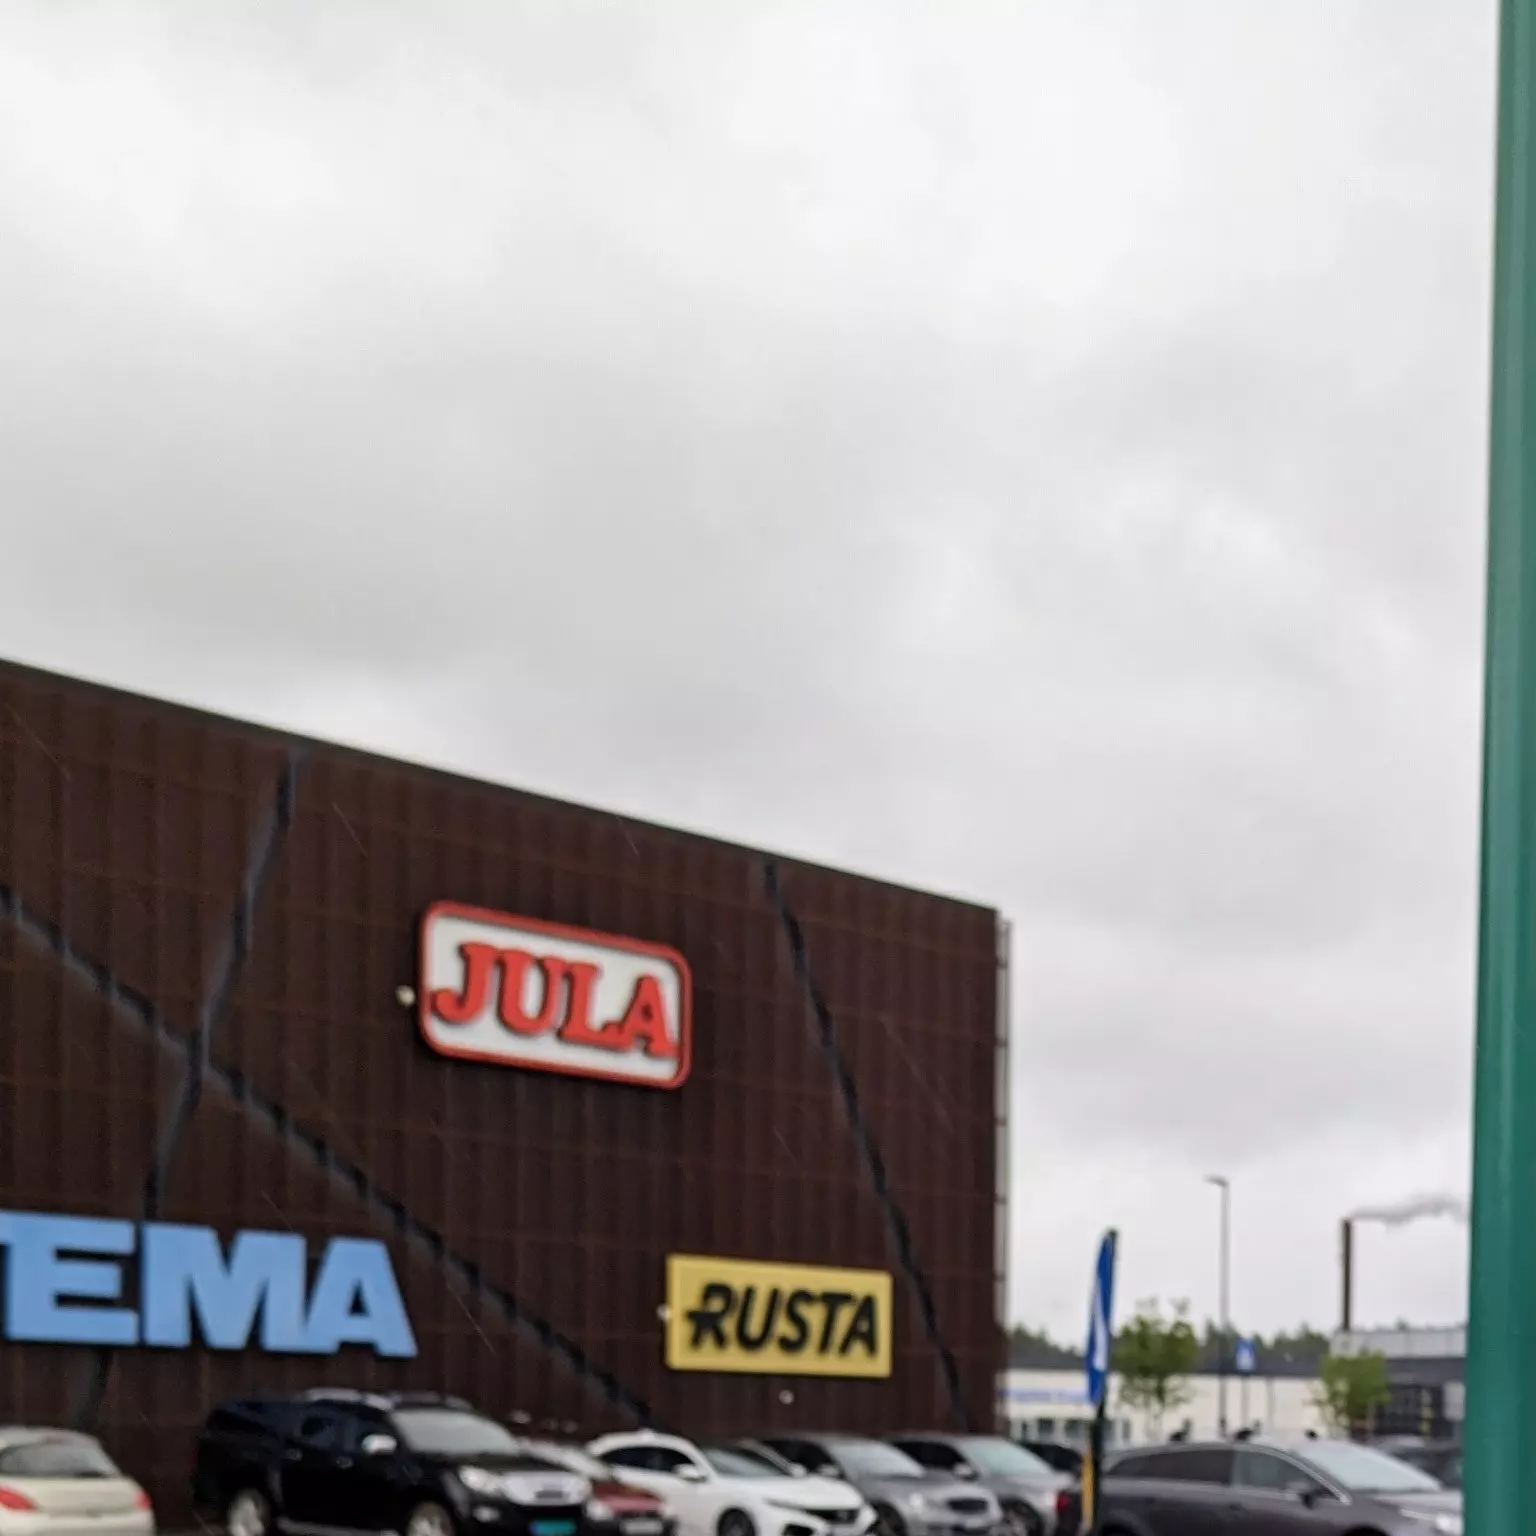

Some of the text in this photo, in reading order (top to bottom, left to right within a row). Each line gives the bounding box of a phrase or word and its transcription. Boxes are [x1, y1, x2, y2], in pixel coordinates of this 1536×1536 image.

[430, 940, 679, 1056] JULA
[0, 1209, 418, 1358] EMA
[684, 1283, 878, 1357] RUSTA
